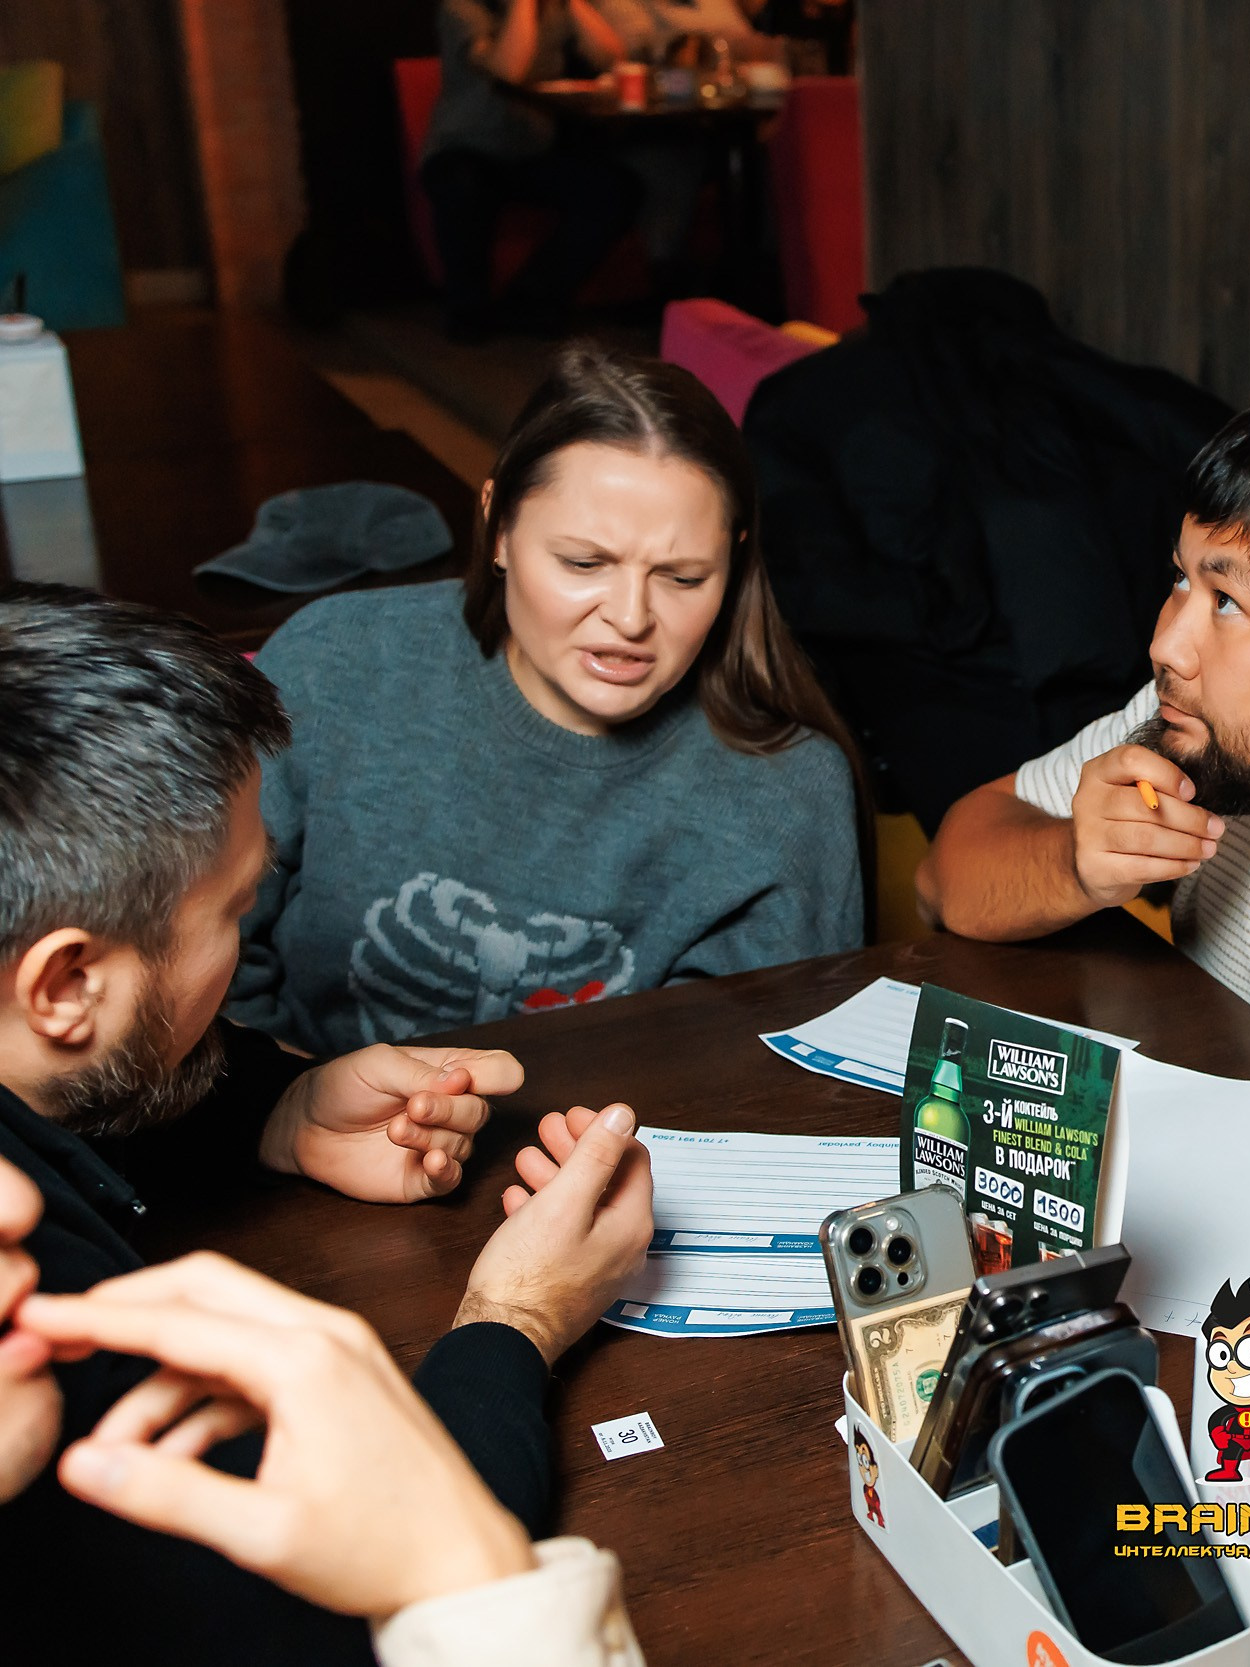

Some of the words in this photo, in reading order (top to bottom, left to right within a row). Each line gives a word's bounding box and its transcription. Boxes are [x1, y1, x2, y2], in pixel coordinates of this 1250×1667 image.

[997, 1045, 1056, 1071] WILLIAM
[992, 1059, 1059, 1088] LAWSON'S
[982, 1098, 1013, 1129] 3-Й
[1014, 1099, 1059, 1121] КОКТЕЙЛЬ
[993, 1129, 1022, 1147] FINEST
[1025, 1136, 1052, 1154] BLEND
[1055, 1143, 1062, 1156] &
[1014, 1117, 1052, 1137] WILLIAM
[1054, 1125, 1099, 1147] LAWSON'S
[915, 1147, 965, 1177] LAWSON'S
[917, 1135, 964, 1164] WILLIAM
[995, 1145, 1005, 1165] В
[931, 1170, 950, 1181] SCOTCH
[978, 1171, 1022, 1204] 3000
[981, 1200, 996, 1213] ЦЕНА
[997, 1206, 1005, 1215] ЗА
[1005, 1210, 1017, 1221] СЕТ
[1037, 1195, 1081, 1226] 1500
[1033, 1221, 1049, 1234] ЦЕНА
[1049, 1228, 1058, 1238] ЗА
[869, 1327, 892, 1348] 2
[618, 1429, 639, 1444] 30
